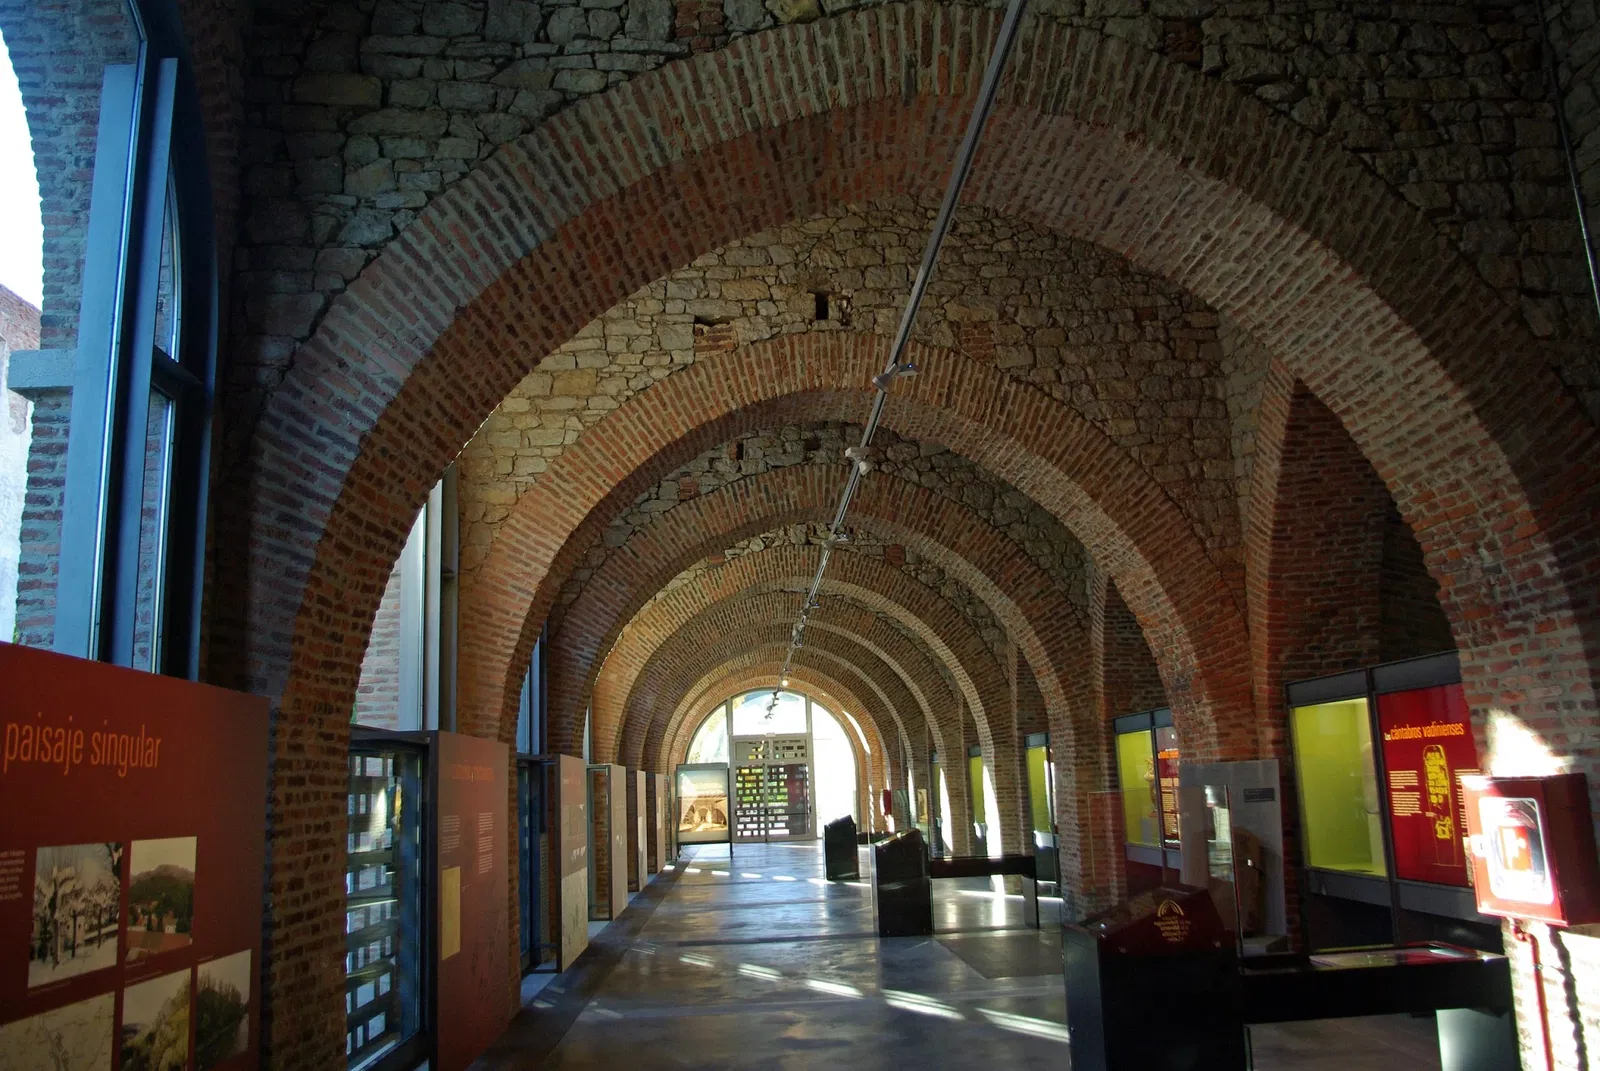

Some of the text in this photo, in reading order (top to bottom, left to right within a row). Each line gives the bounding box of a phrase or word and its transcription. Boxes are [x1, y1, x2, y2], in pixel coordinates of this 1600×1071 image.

[3, 711, 162, 778] paisaje singular
[1391, 724, 1422, 740] cántabros
[1422, 720, 1464, 738] vadinienses
